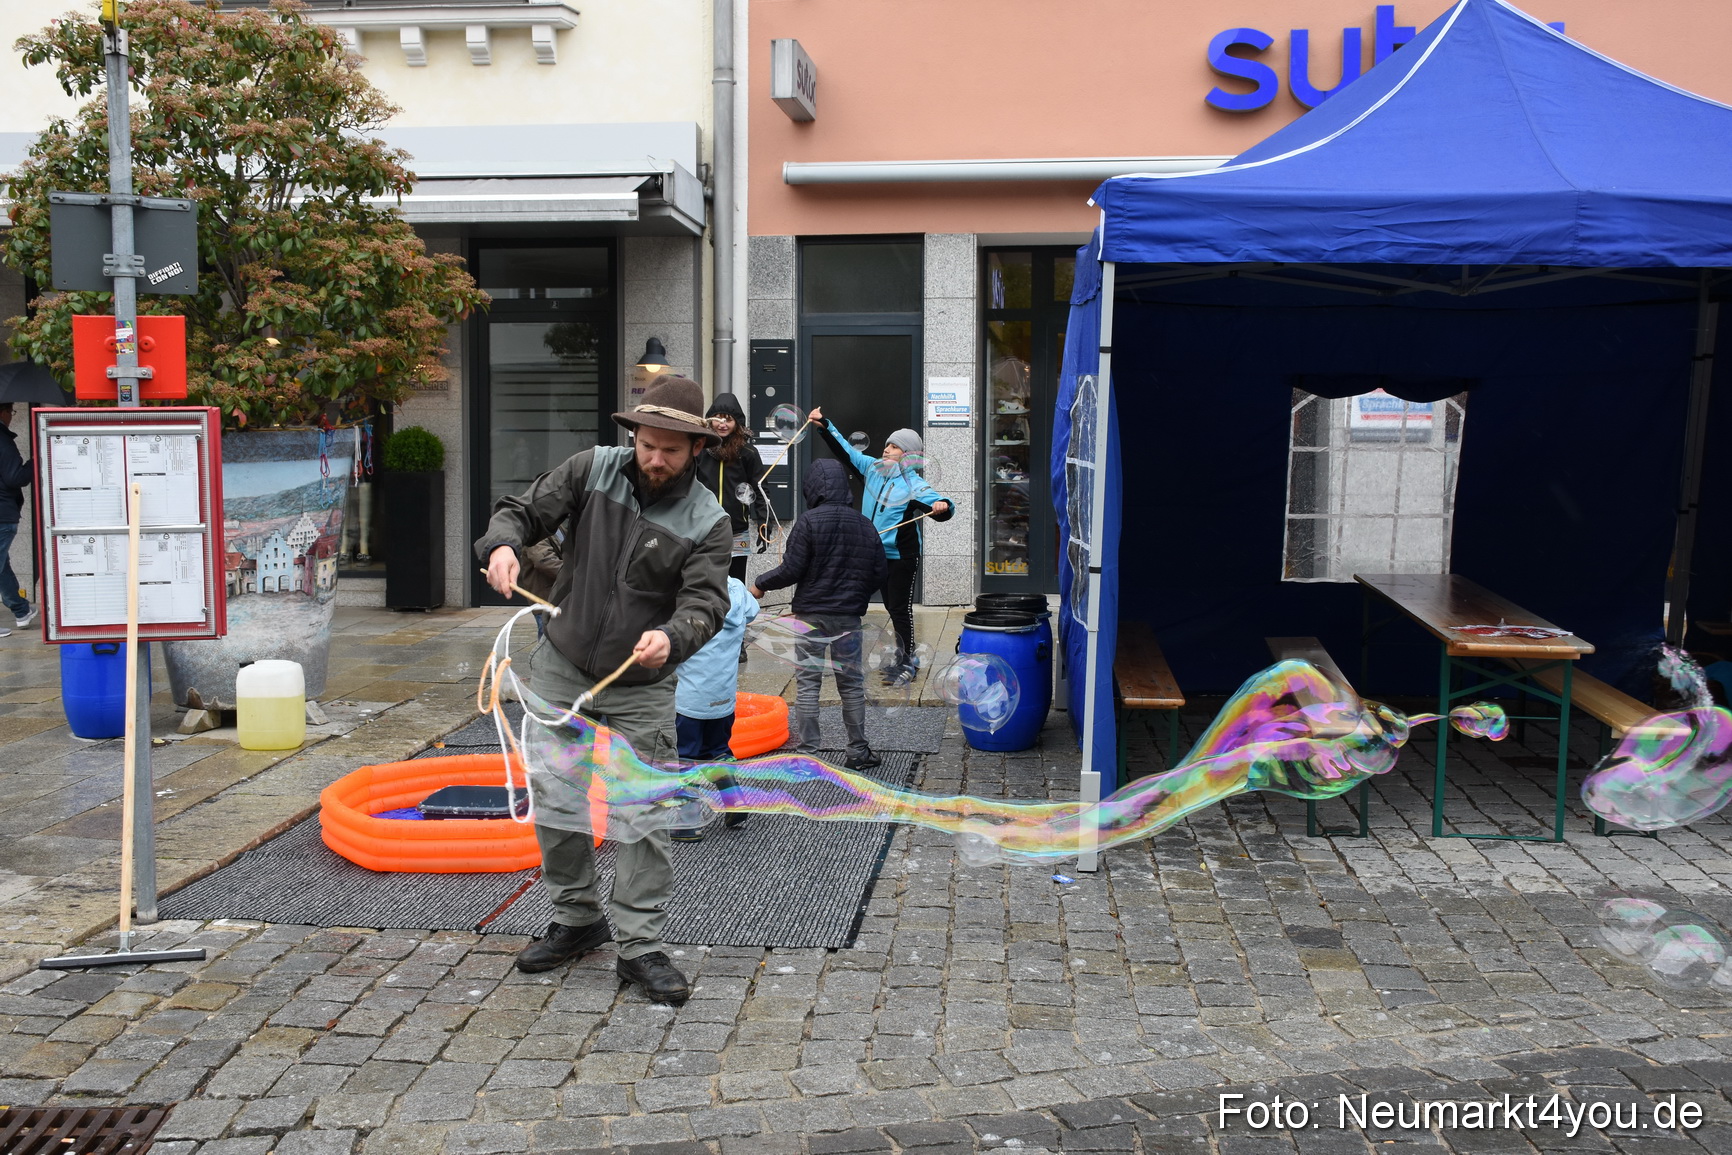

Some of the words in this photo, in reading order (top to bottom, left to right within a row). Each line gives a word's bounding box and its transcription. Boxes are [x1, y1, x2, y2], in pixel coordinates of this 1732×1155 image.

[1204, 5, 1565, 111] sut
[150, 272, 169, 285] CON
[168, 266, 184, 278] NOI
